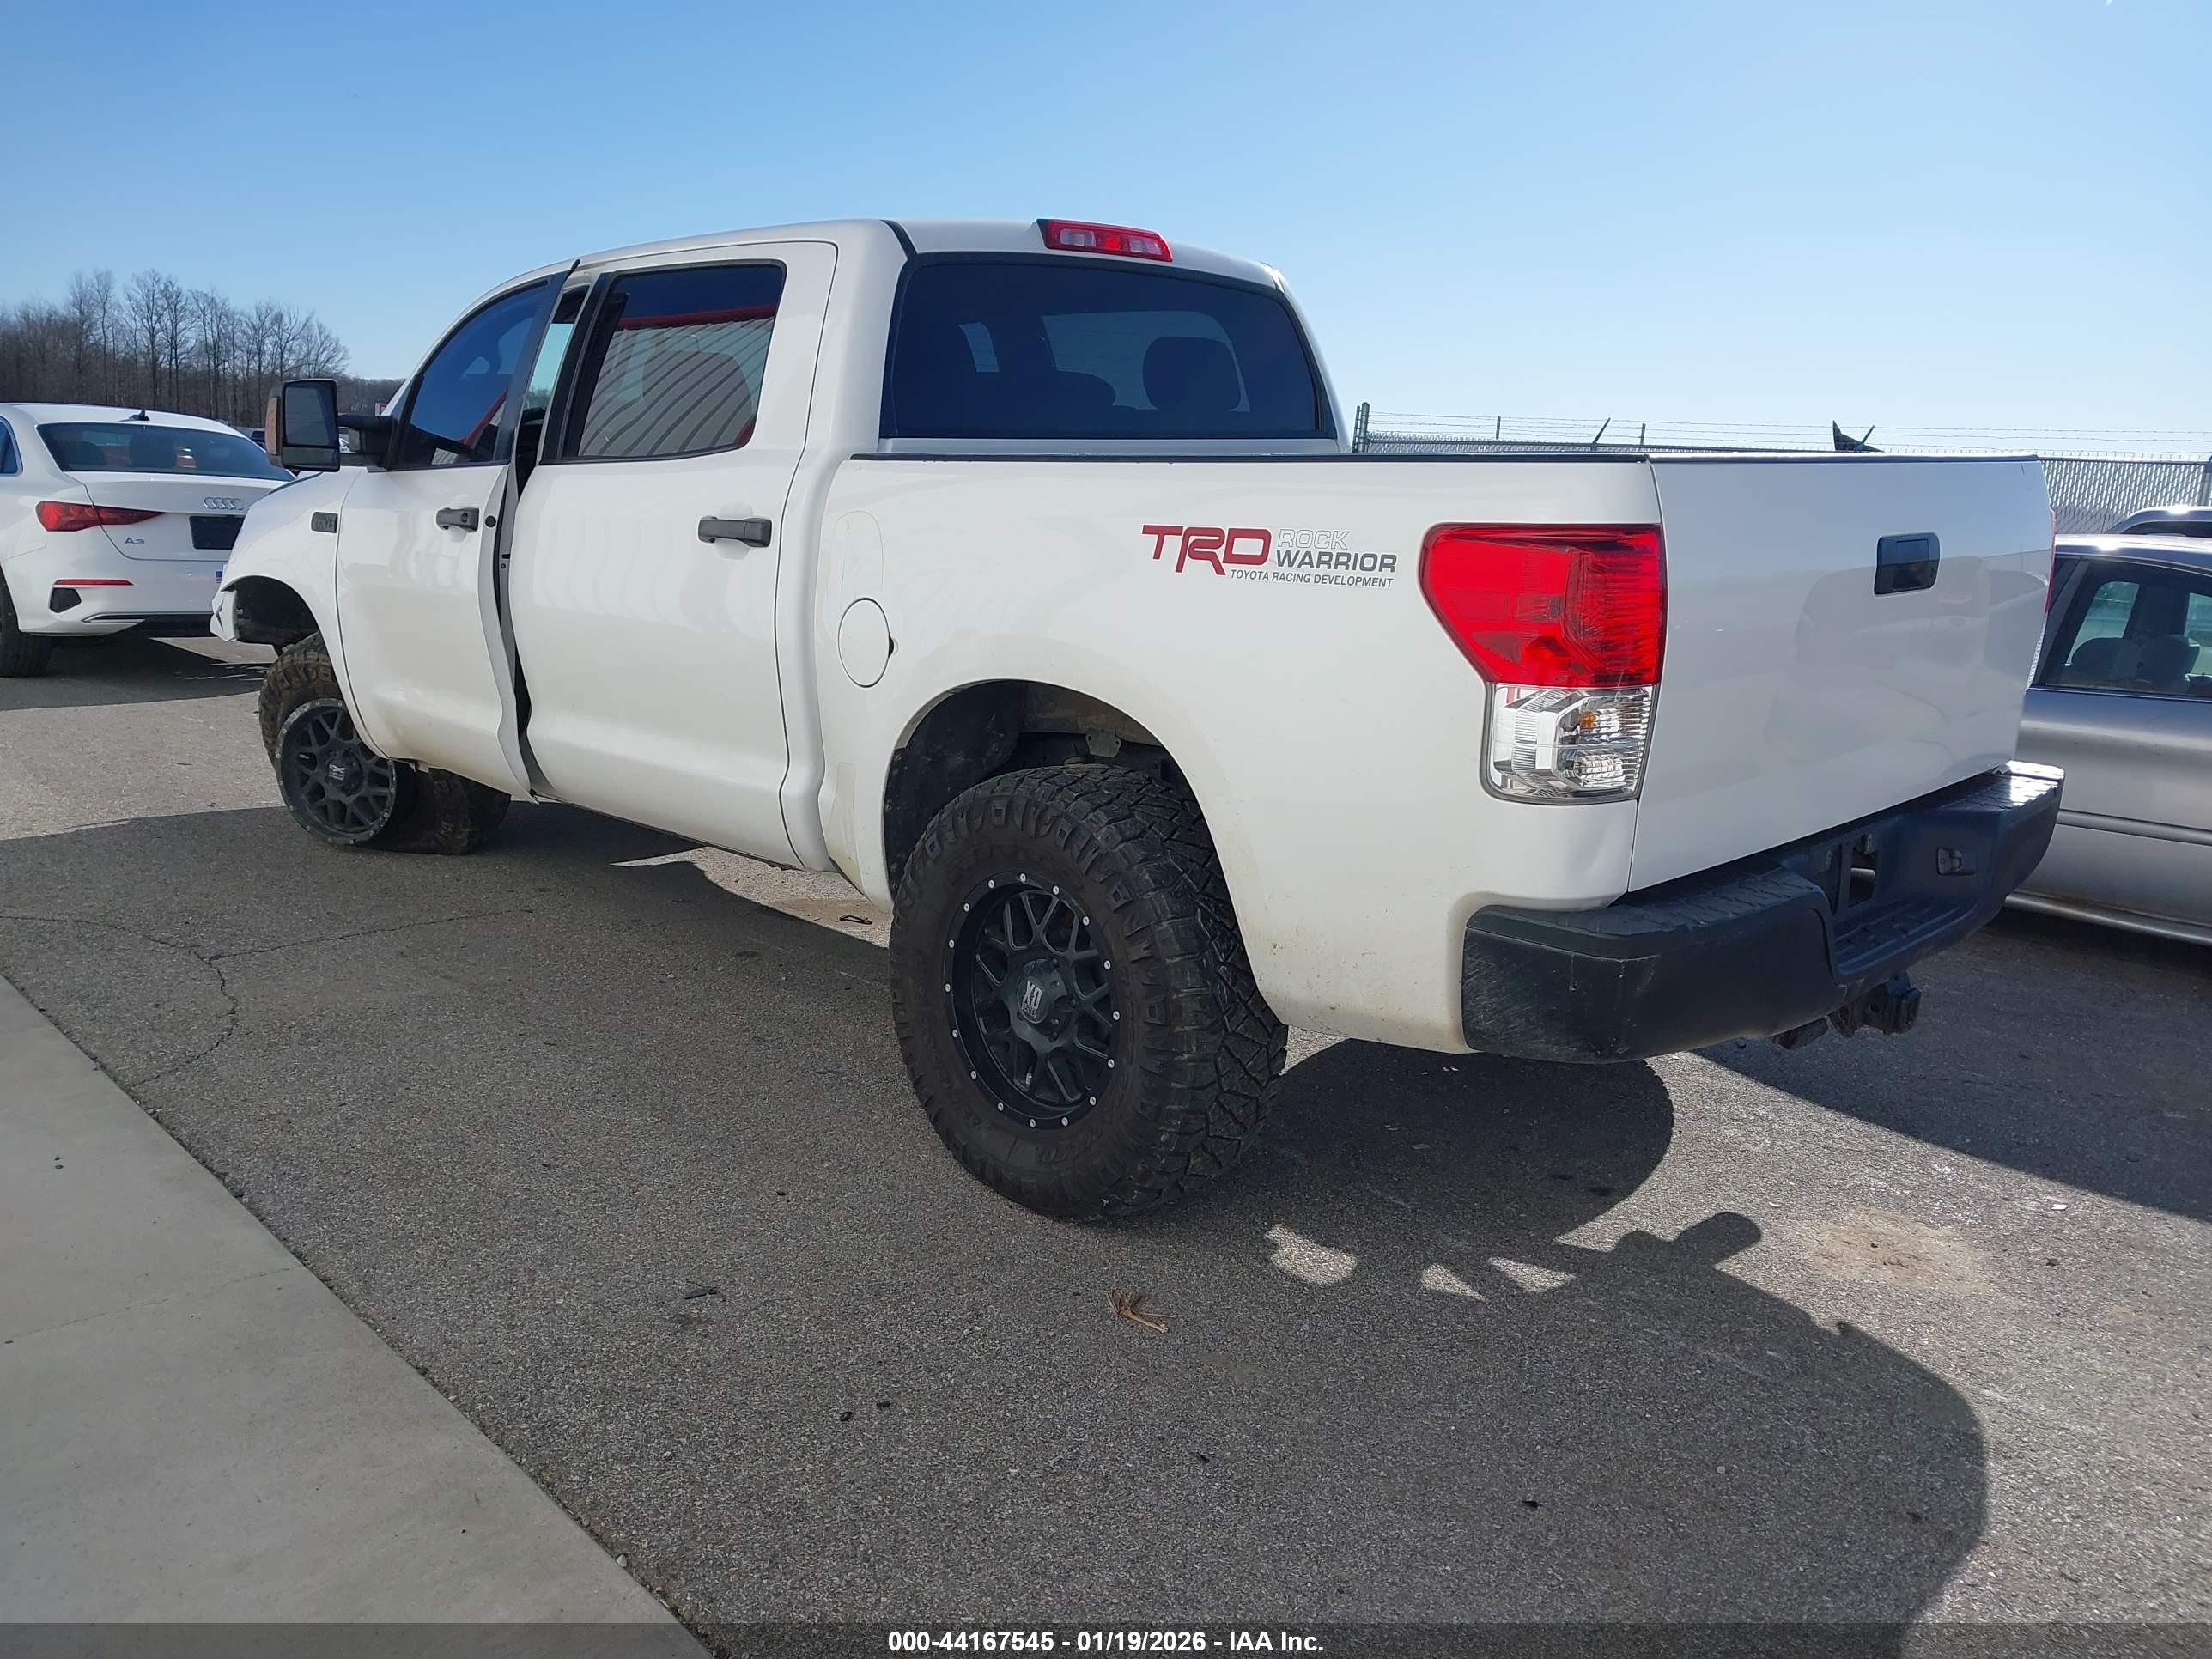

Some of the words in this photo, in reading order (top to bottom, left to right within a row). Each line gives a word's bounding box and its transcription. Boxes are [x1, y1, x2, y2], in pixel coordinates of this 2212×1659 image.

[124, 537, 145, 545] A3
[1142, 525, 1273, 575] TRD
[1278, 528, 1351, 550] ROCK
[1276, 550, 1398, 573] WARRIOR
[1231, 569, 1270, 582] TOYOTA
[1272, 572, 1311, 585] RACING
[1313, 574, 1394, 588] DEVELOPMENT
